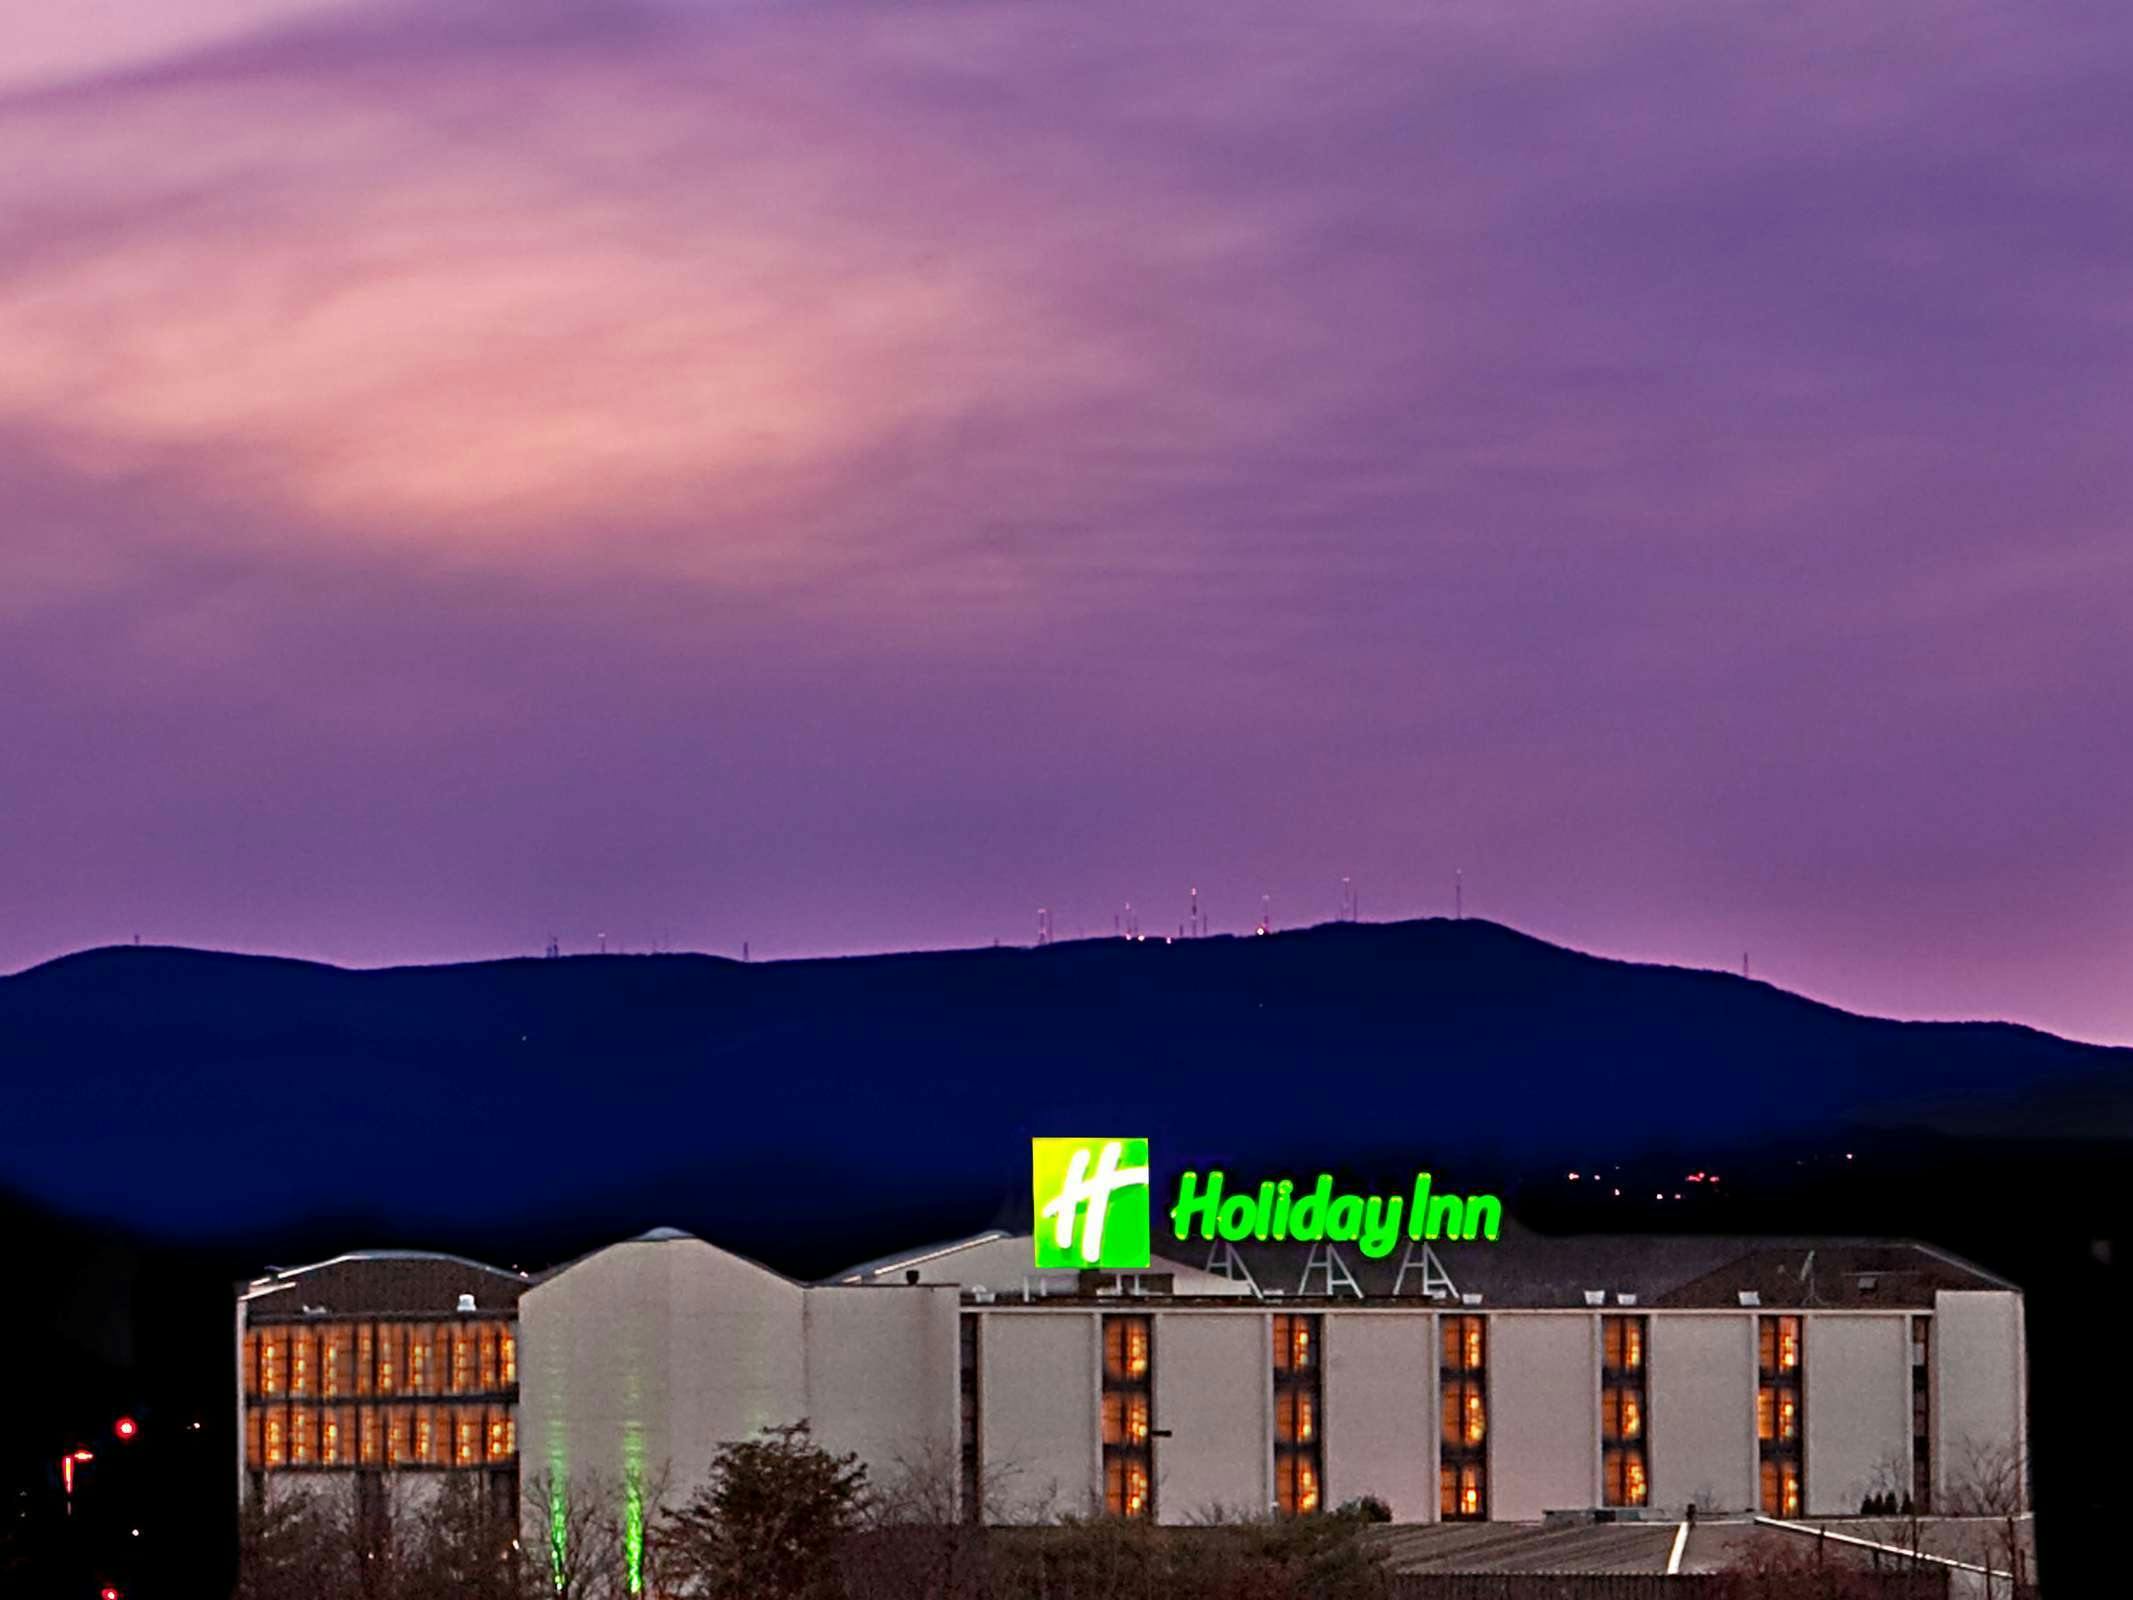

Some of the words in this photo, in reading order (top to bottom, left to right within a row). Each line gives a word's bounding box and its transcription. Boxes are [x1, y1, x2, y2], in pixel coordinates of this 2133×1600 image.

[1043, 1141, 1149, 1263] H
[1170, 1171, 1403, 1259] Holiday
[1408, 1172, 1502, 1241] Inn
